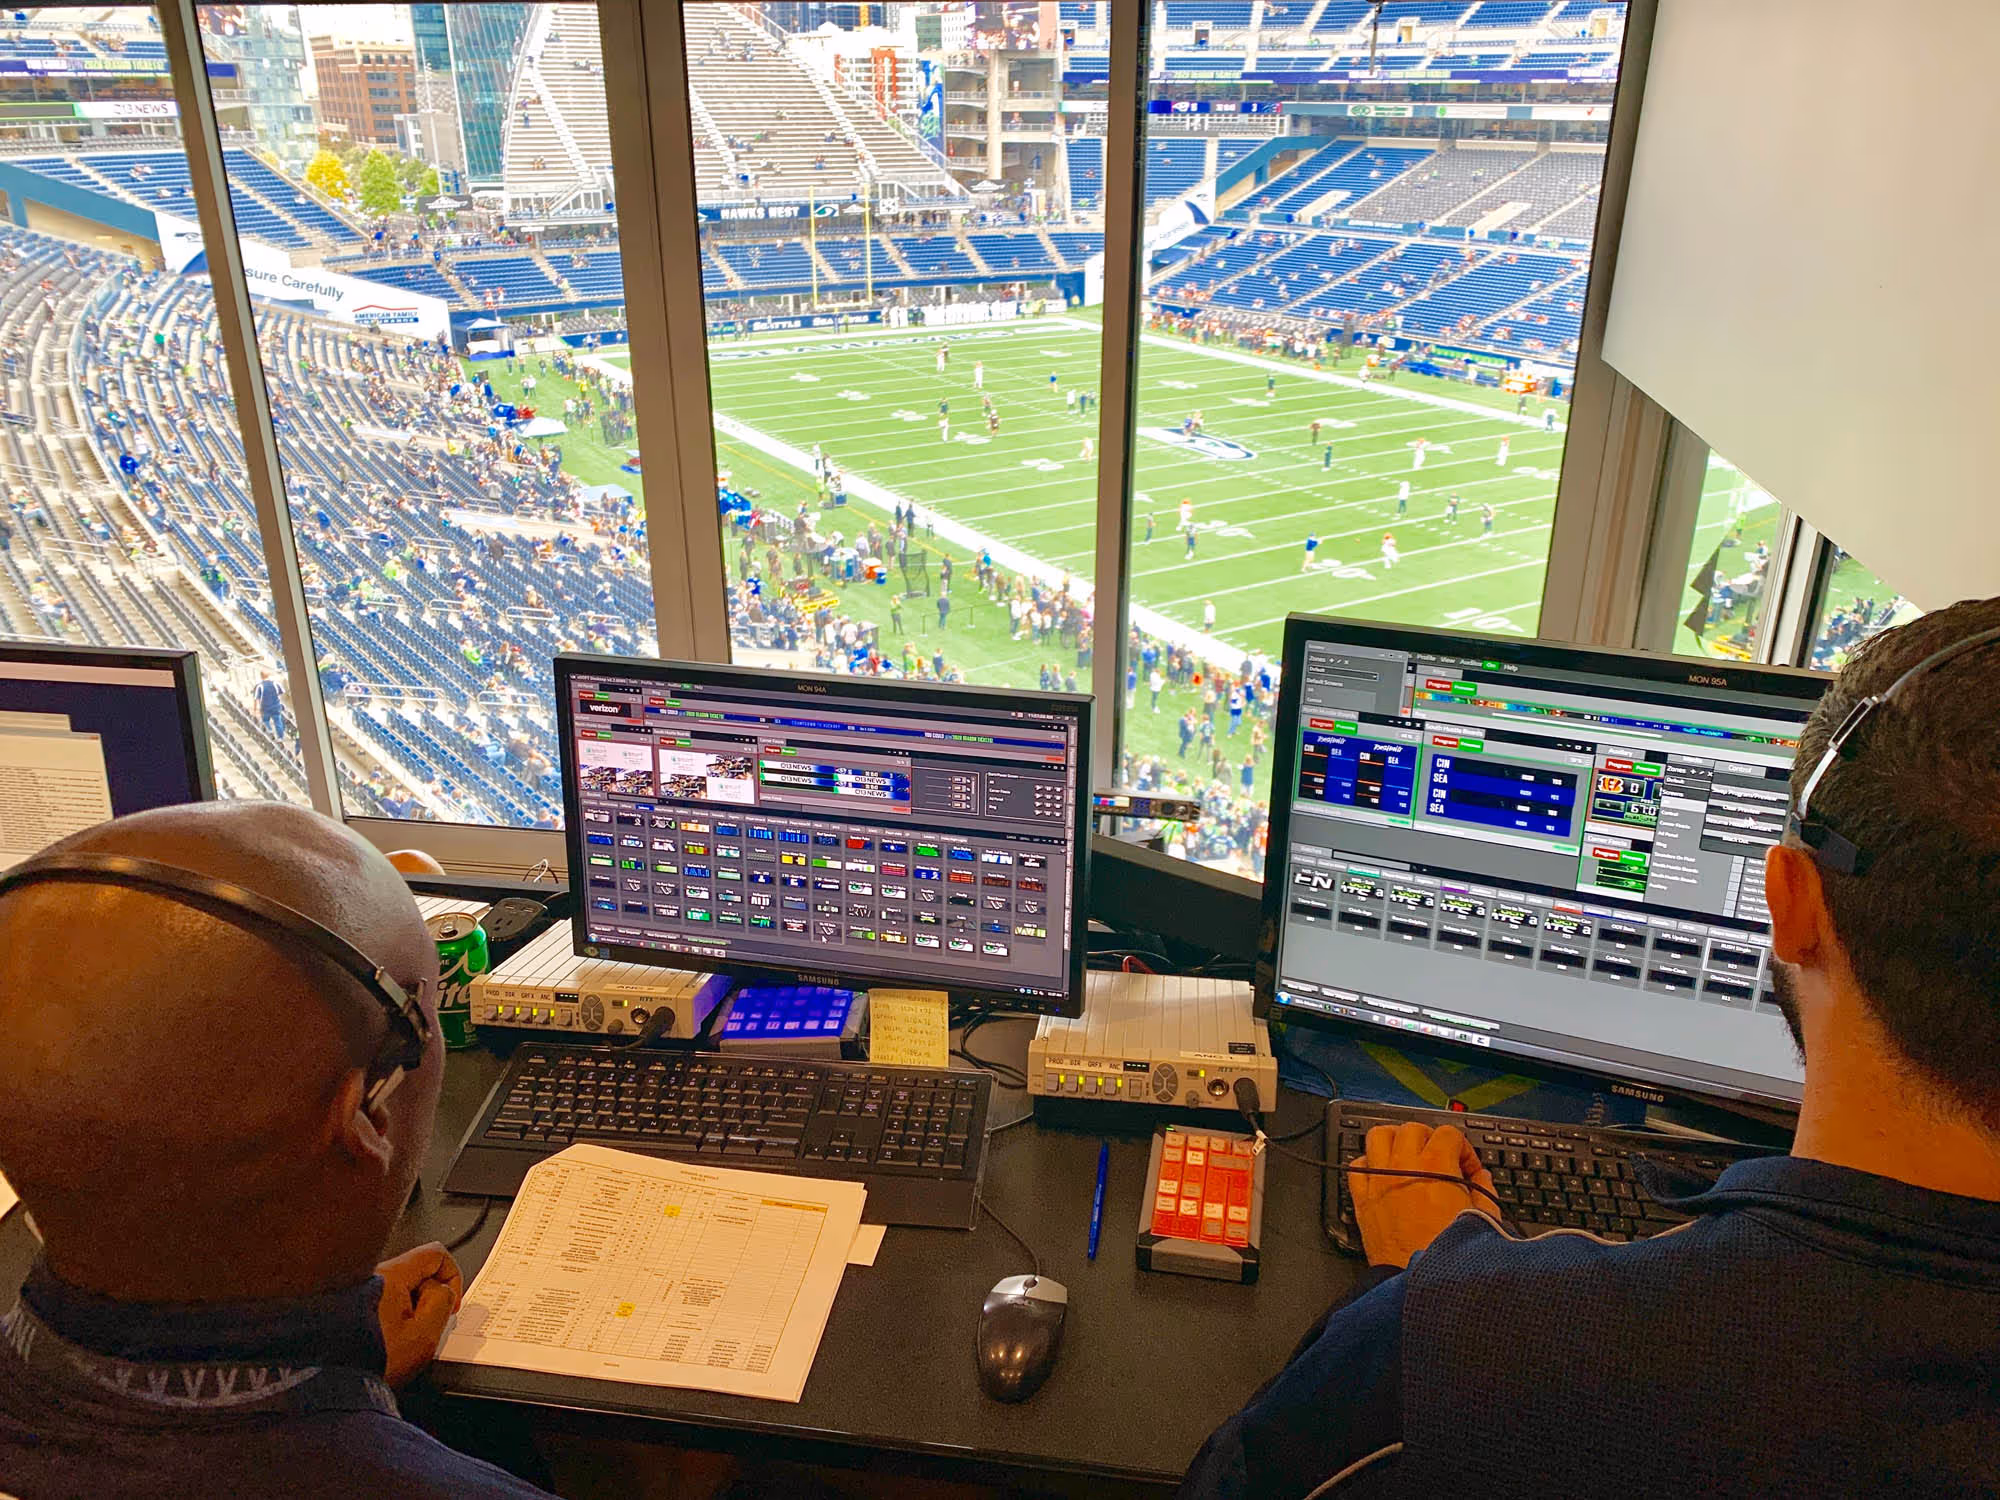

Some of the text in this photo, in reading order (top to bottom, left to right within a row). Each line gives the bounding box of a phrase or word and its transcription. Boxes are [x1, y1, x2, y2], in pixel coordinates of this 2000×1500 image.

[721, 206, 765, 219] HAWKS
[282, 274, 344, 302] Carefully
[392, 311, 418, 319] FAMILY
[1689, 674, 1727, 687] MON 95A
[798, 684, 813, 692] MON
[589, 703, 619, 714] verizon
[794, 763, 812, 771] NEWS
[1436, 758, 1450, 769] CIN
[1667, 766, 1686, 774] Zones
[794, 776, 812, 784] NEWS
[868, 777, 887, 785] NEWS
[1433, 772, 1448, 784] SEA
[868, 789, 887, 797] NEWS
[1433, 788, 1446, 799] CIN
[1430, 803, 1445, 814] SEA
[798, 974, 840, 986] SAMSUNG
[1048, 1057, 1064, 1065] PROD
[1610, 1084, 1665, 1103] SAMSUNG
